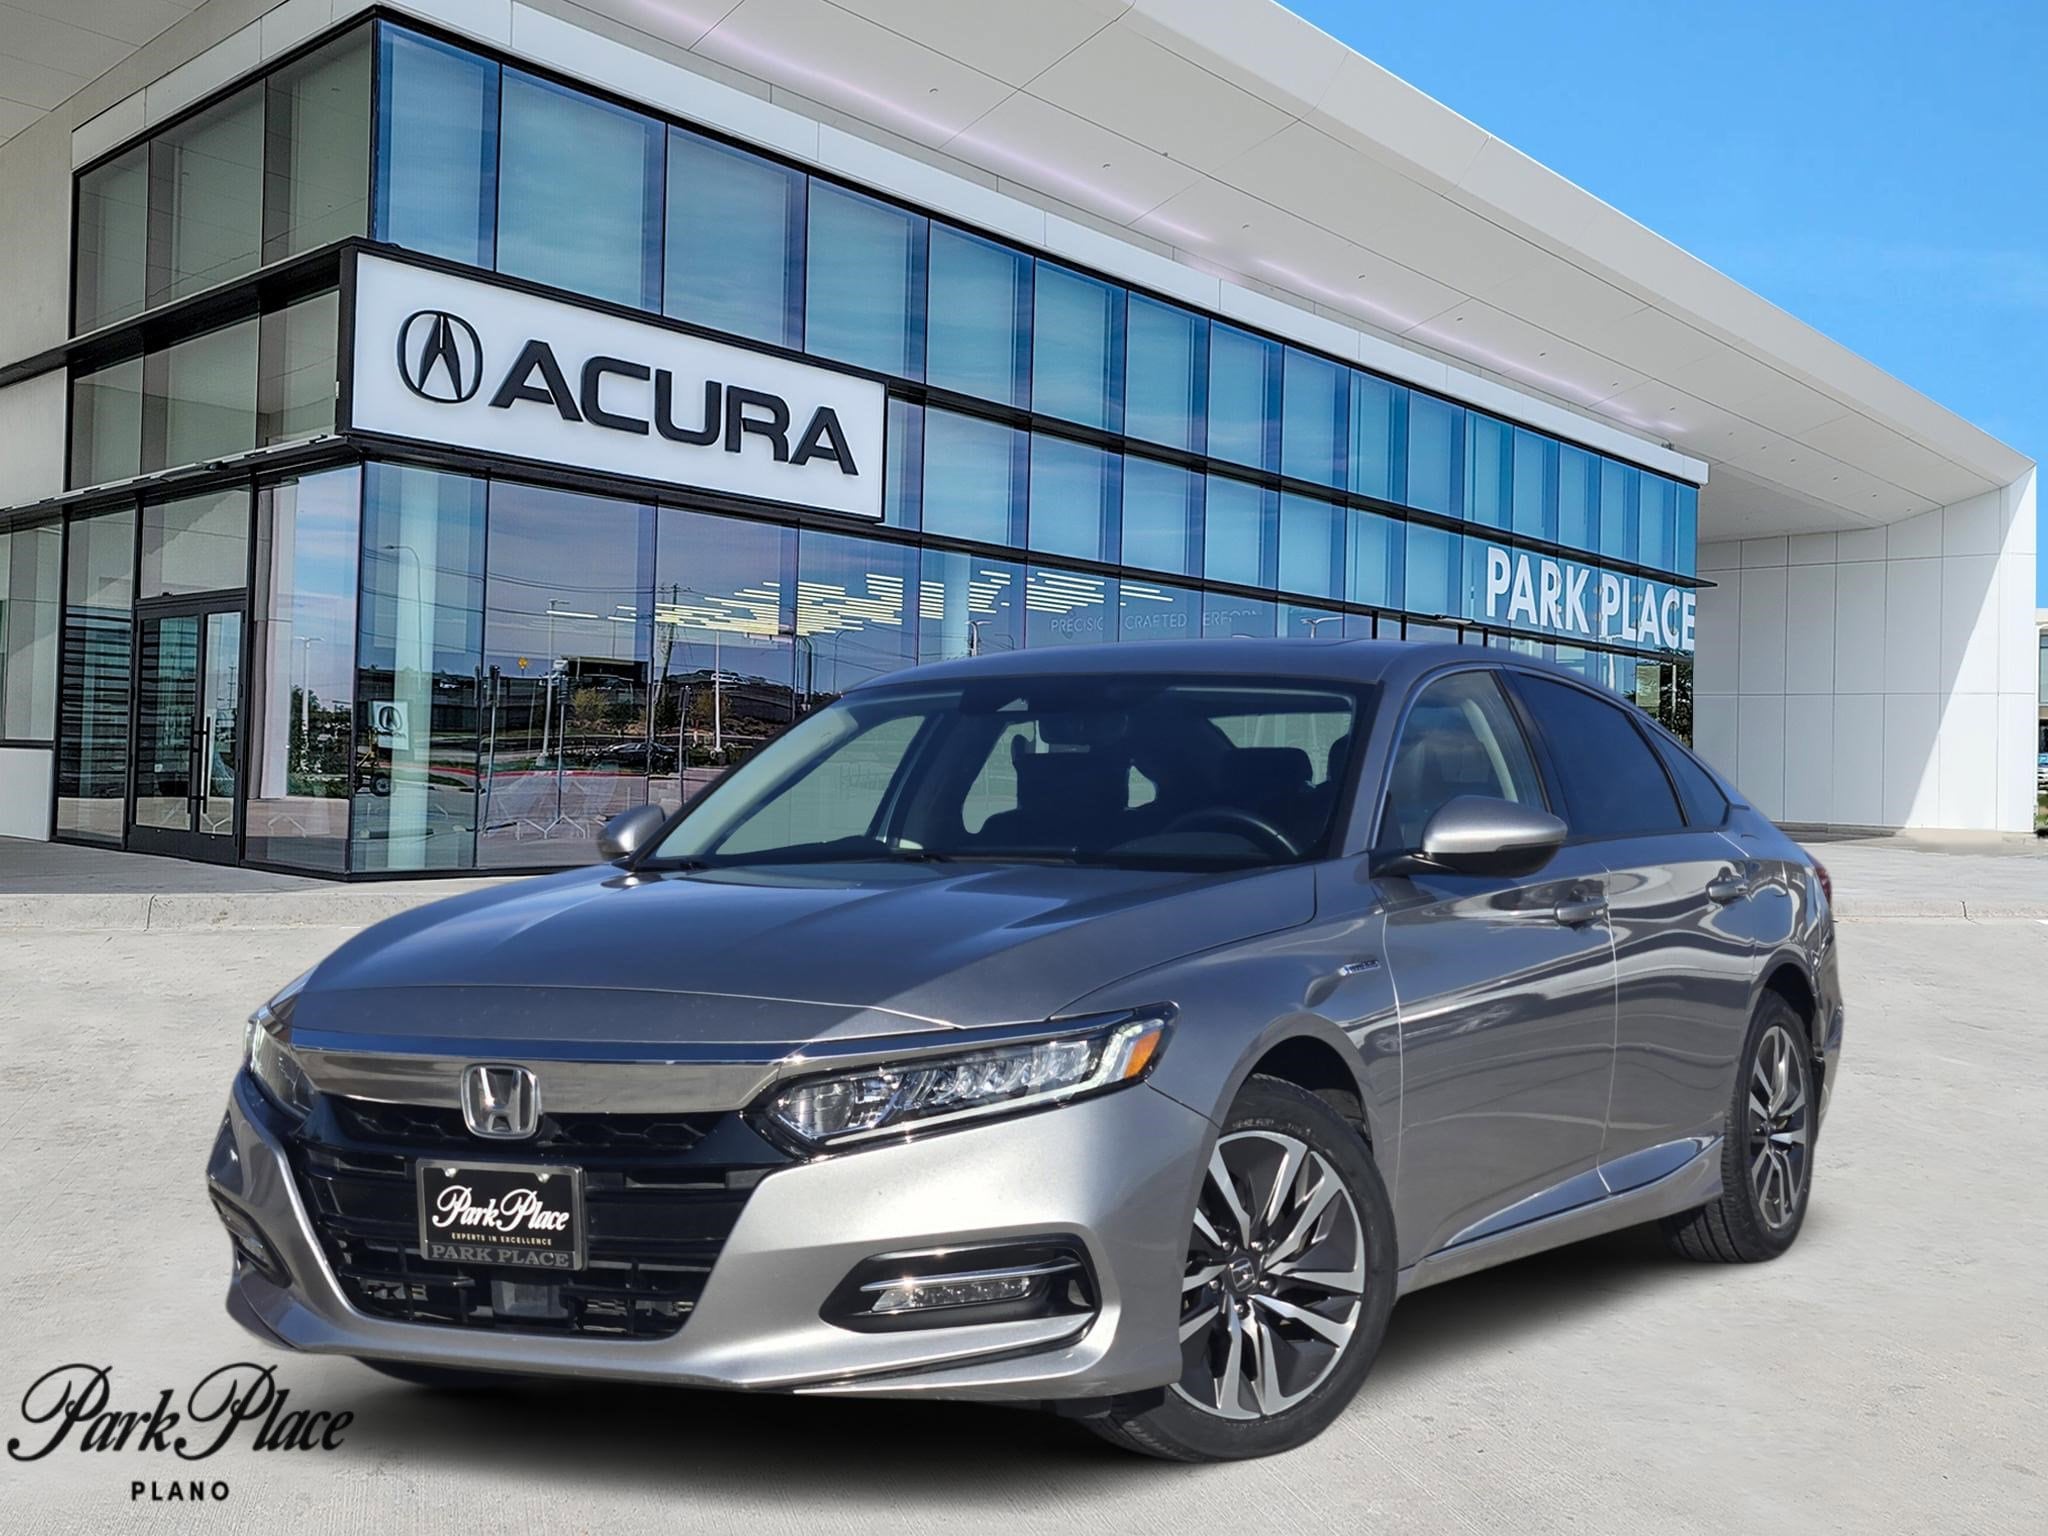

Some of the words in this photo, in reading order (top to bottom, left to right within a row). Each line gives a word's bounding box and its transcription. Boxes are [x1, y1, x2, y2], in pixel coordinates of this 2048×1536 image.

[488, 339, 859, 477] ACURA
[1486, 546, 1590, 634] PARK
[1600, 573, 1696, 651] PLACE
[1124, 613, 1188, 630] CRAFTED
[432, 1185, 500, 1228] Park
[496, 1188, 570, 1232] Place
[431, 1244, 493, 1262] PARK
[497, 1248, 569, 1267] PLACE
[451, 1232, 485, 1242] EXPERTS
[500, 1236, 552, 1246] EXCELLENCE
